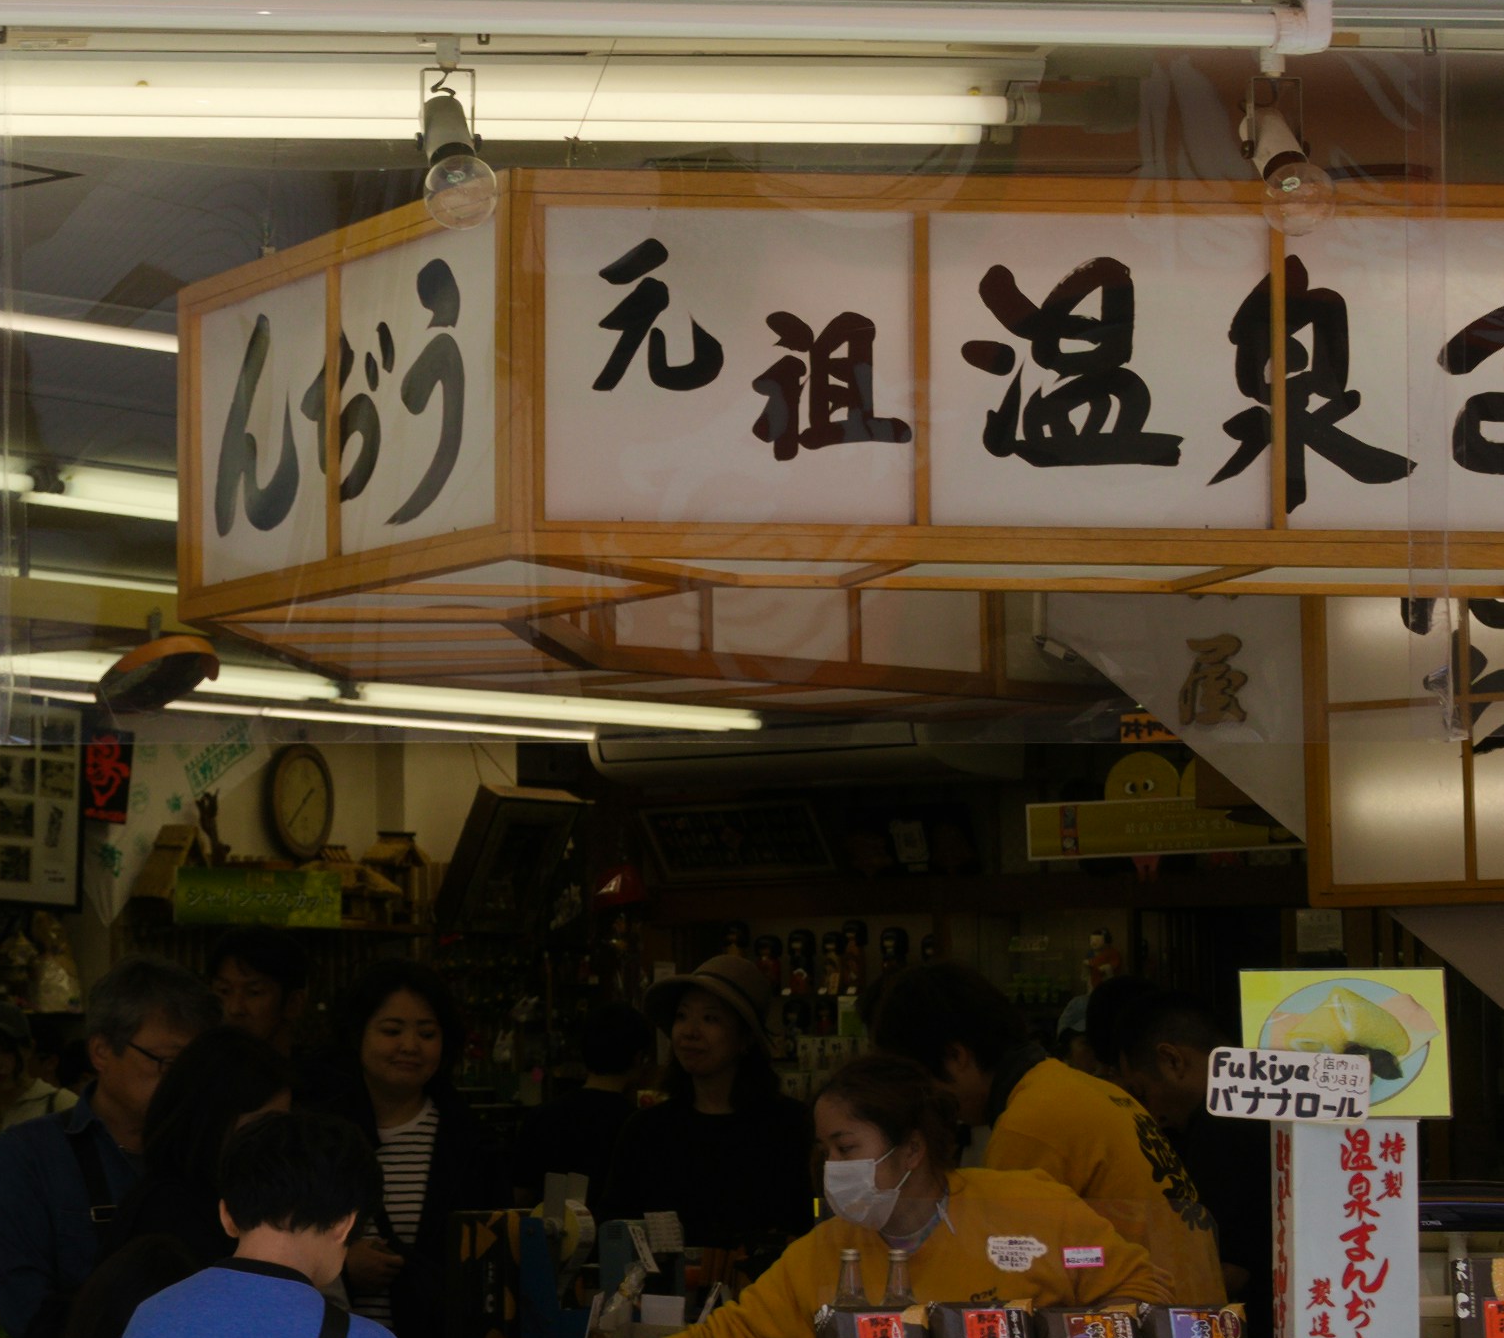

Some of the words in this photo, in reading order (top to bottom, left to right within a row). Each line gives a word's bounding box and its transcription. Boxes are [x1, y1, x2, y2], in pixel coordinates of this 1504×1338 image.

[592, 237, 911, 462] 元祖
[214, 258, 466, 537] んぢう
[1212, 1050, 1311, 1086] Fukiya
[1322, 1057, 1360, 1072] 店内に
[1208, 1084, 1363, 1119] バナナロール
[1378, 1131, 1406, 1201] 特製
